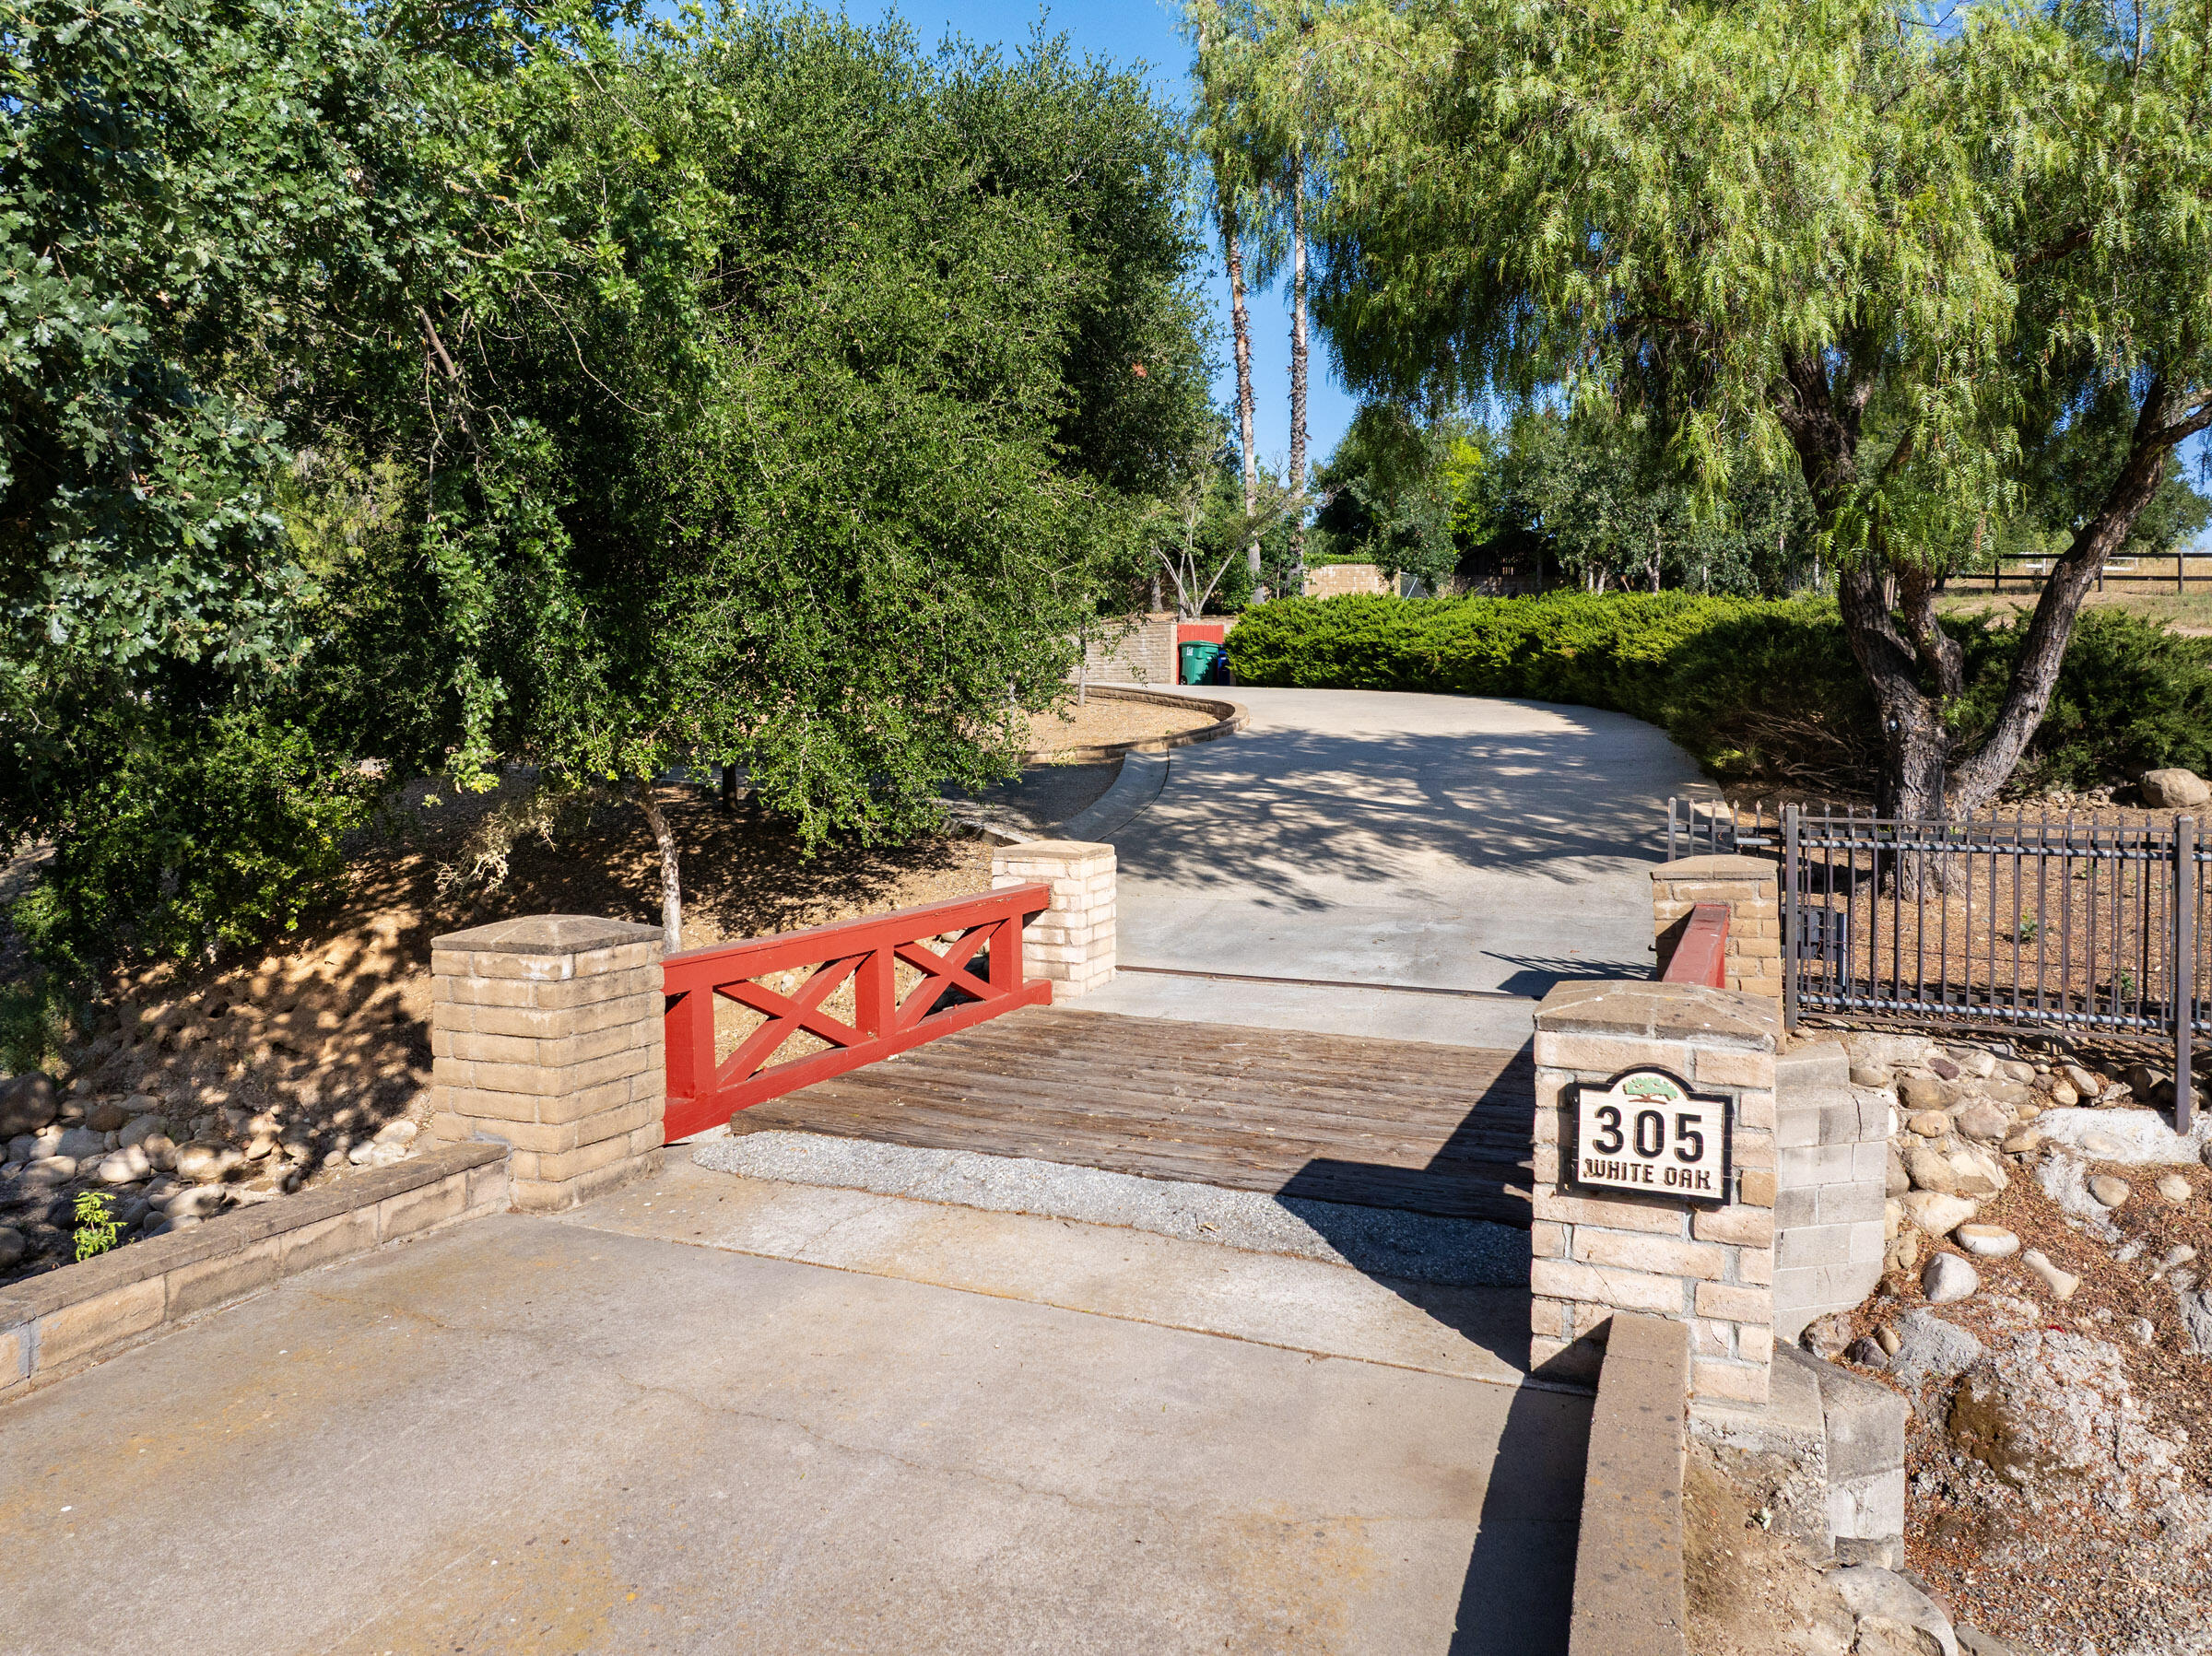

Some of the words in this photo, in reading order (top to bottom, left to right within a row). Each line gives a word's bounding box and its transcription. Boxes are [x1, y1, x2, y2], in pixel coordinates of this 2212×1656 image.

[1593, 1106, 1704, 1163] 305
[1584, 1158, 1654, 1183] WHITE
[1665, 1167, 1712, 1190] OAK
